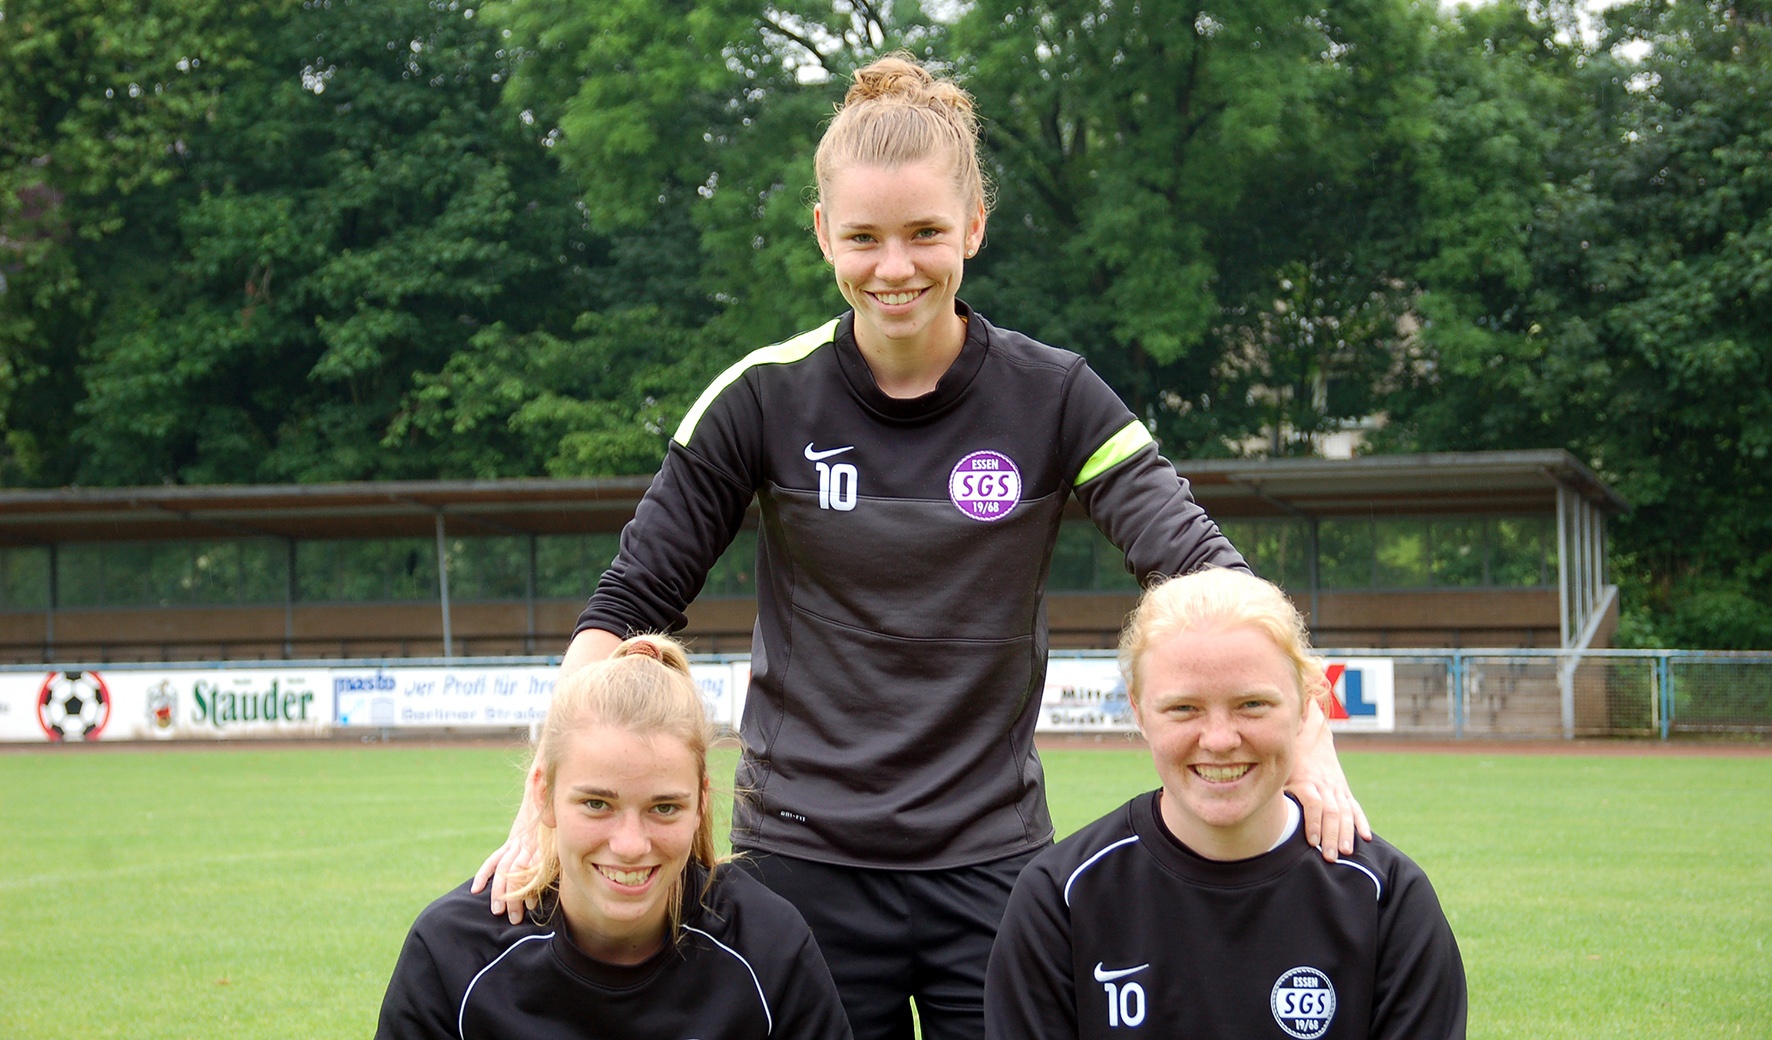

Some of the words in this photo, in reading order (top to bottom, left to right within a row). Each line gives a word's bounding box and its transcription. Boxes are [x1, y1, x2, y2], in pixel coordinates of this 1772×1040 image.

[972, 459, 998, 470] ESSEN
[815, 462, 858, 511] 10
[962, 474, 1010, 497] SGS
[972, 500, 1000, 514] 19/68
[191, 677, 313, 728] Stauder
[1293, 976, 1318, 988] ESSEN
[1104, 982, 1146, 1027] 10
[1284, 992, 1326, 1014] SGS
[1294, 1018, 1319, 1031] 19/68
